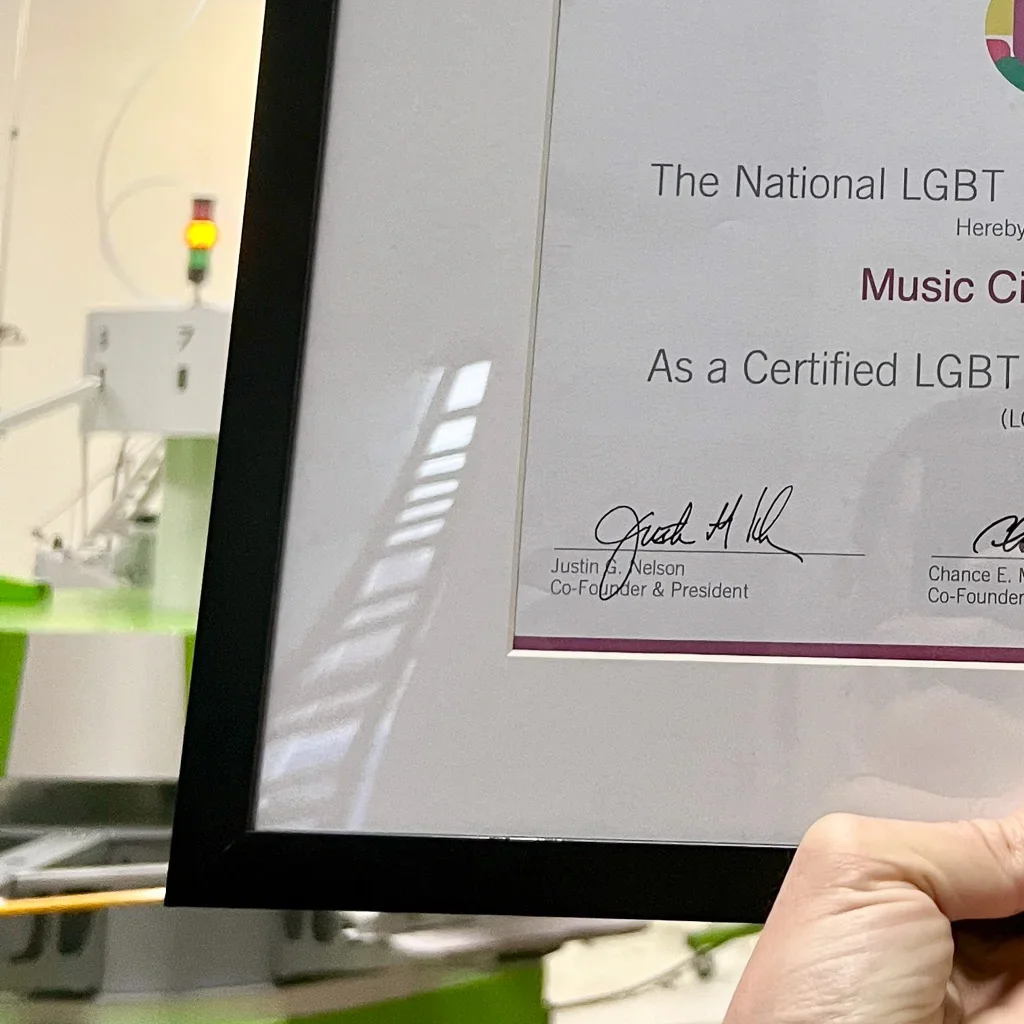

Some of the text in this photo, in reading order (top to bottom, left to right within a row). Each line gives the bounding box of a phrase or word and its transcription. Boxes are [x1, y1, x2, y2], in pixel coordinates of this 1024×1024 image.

[651, 163, 720, 198] The
[735, 165, 886, 200] National
[903, 167, 1005, 202] LGBT
[861, 267, 975, 303] Music
[646, 348, 693, 384] As
[706, 357, 727, 384] a
[743, 349, 898, 387] Certified
[916, 352, 1020, 389] LGBT
[551, 558, 685, 576] Justin G. Nelson
[929, 565, 991, 582] Chance
[997, 566, 1012, 583] E.
[551, 579, 748, 599] Co-Founder & President
[928, 588, 1024, 606] Co-Founder
